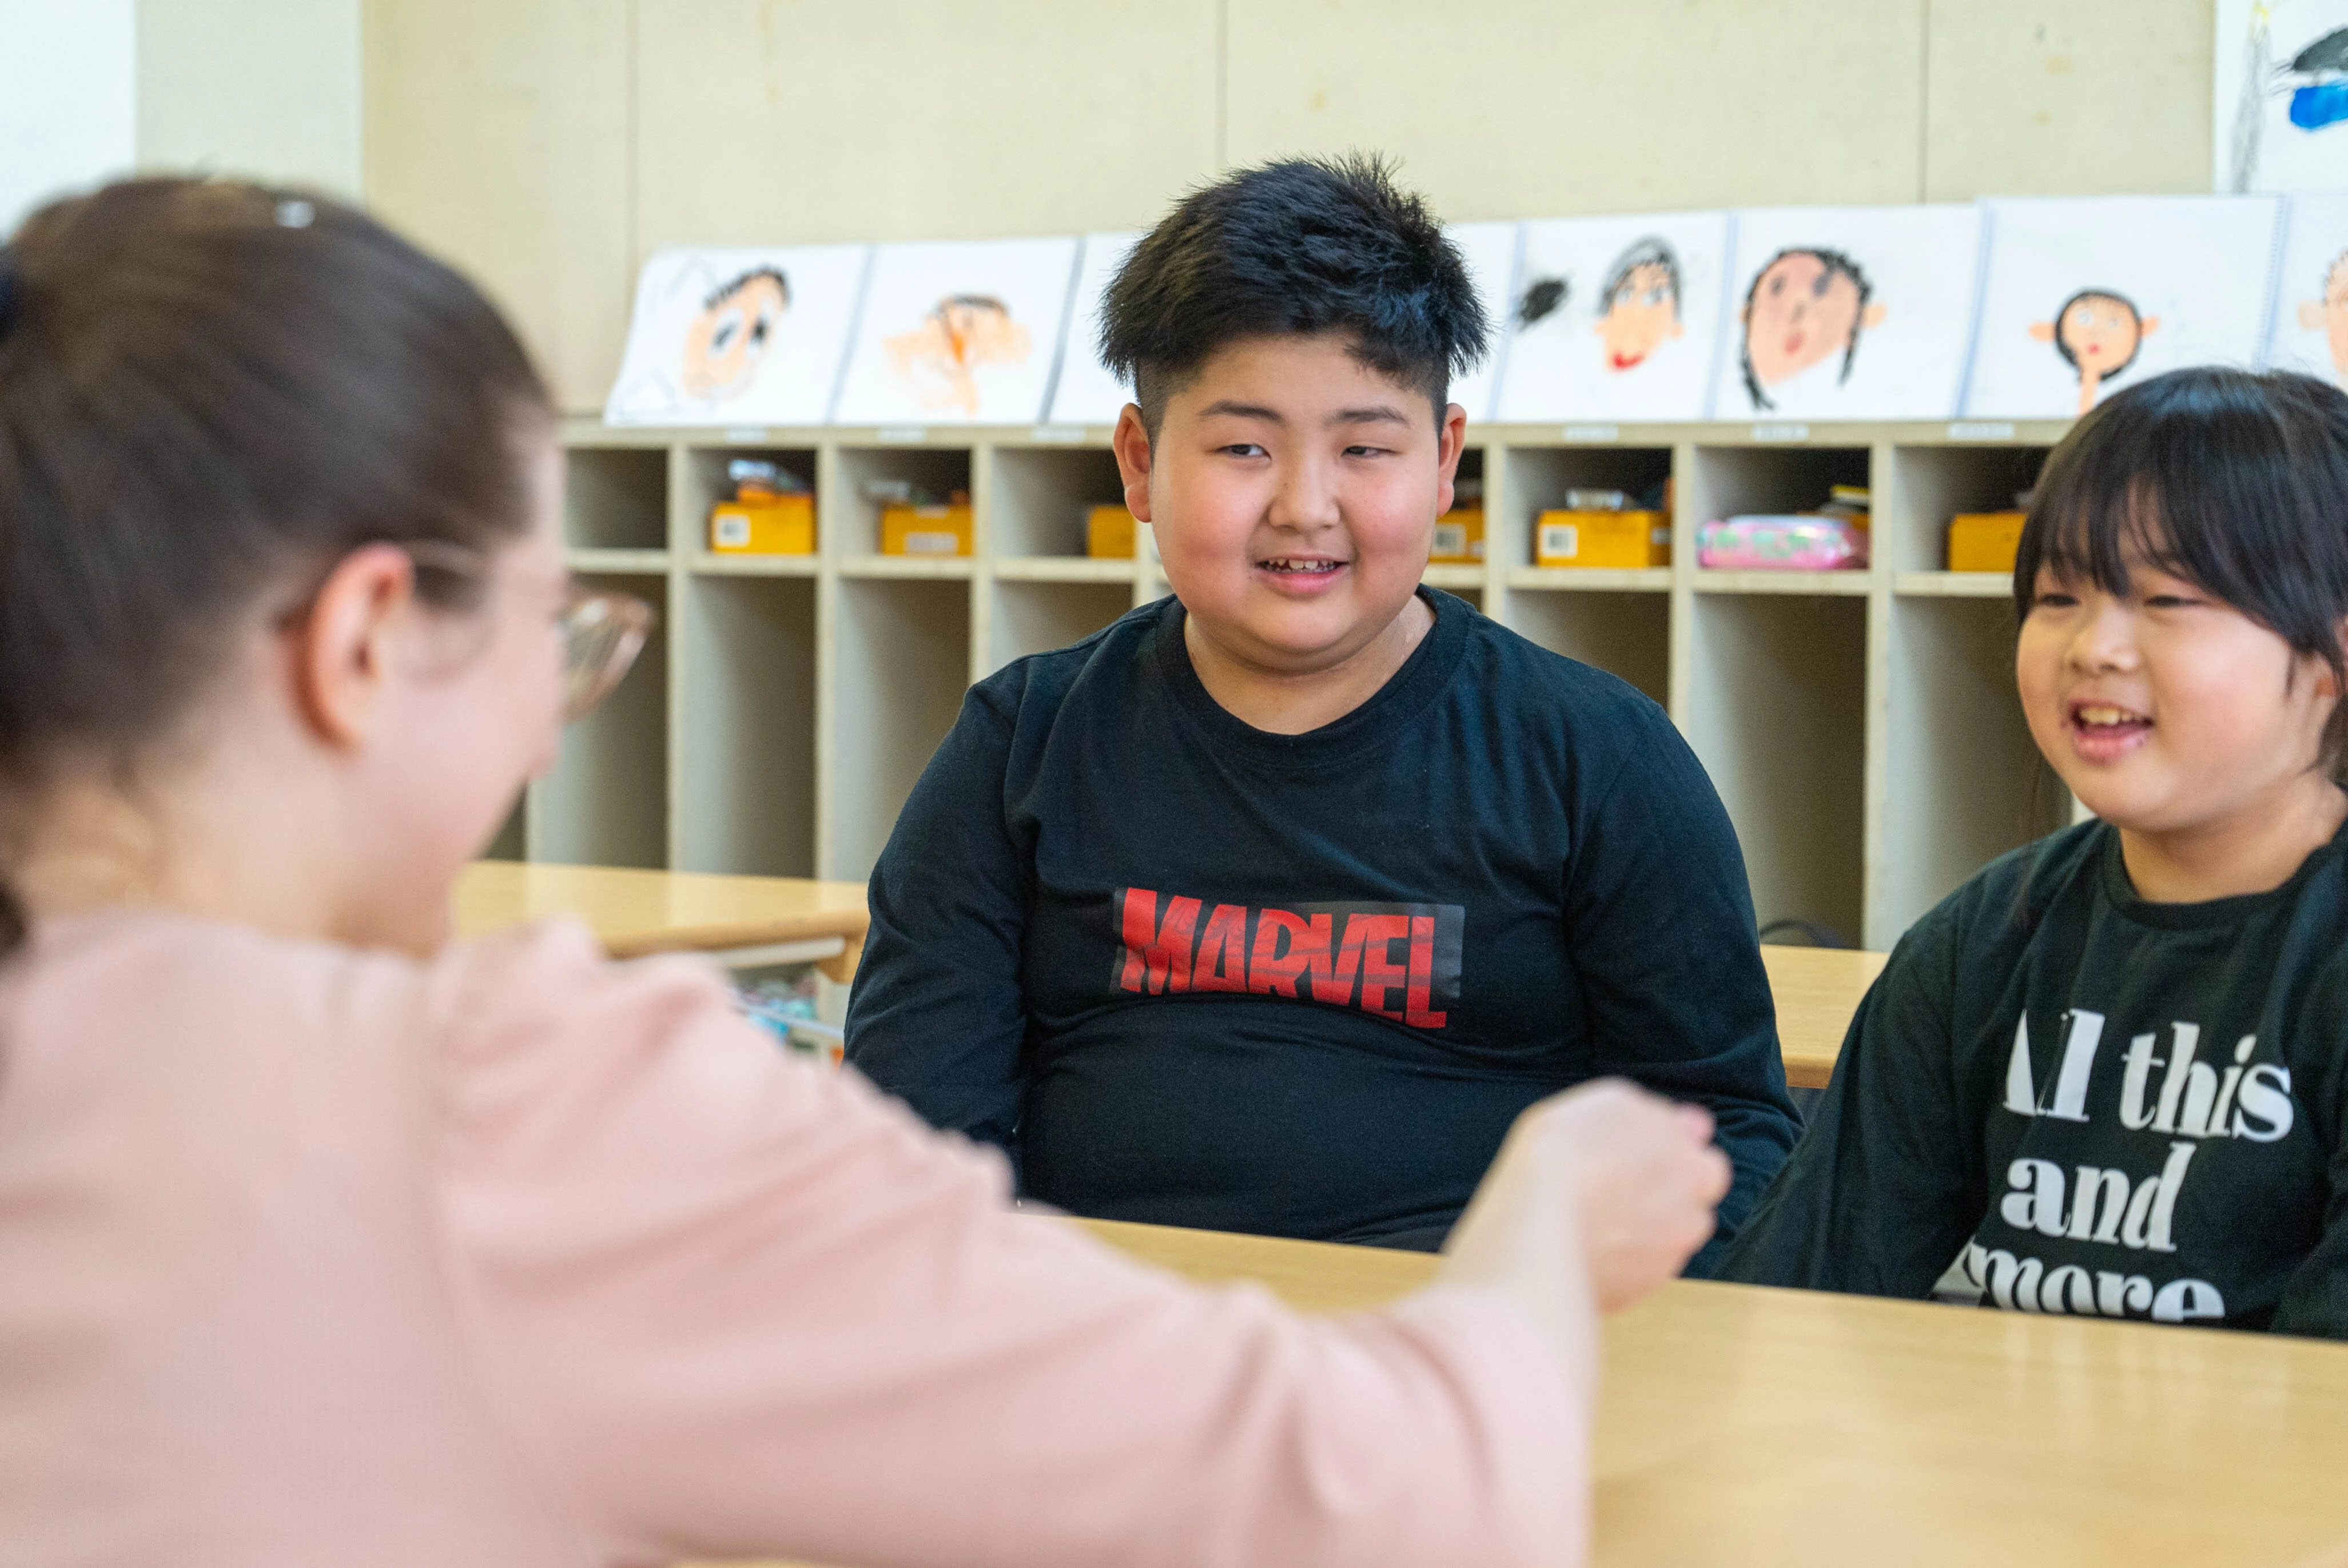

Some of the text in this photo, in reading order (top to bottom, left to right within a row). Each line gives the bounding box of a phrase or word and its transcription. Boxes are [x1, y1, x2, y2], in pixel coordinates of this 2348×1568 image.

[1120, 887, 1447, 1029] MARVEL
[2002, 1008, 2294, 1143] Al this
[2000, 1141, 2197, 1253] and
